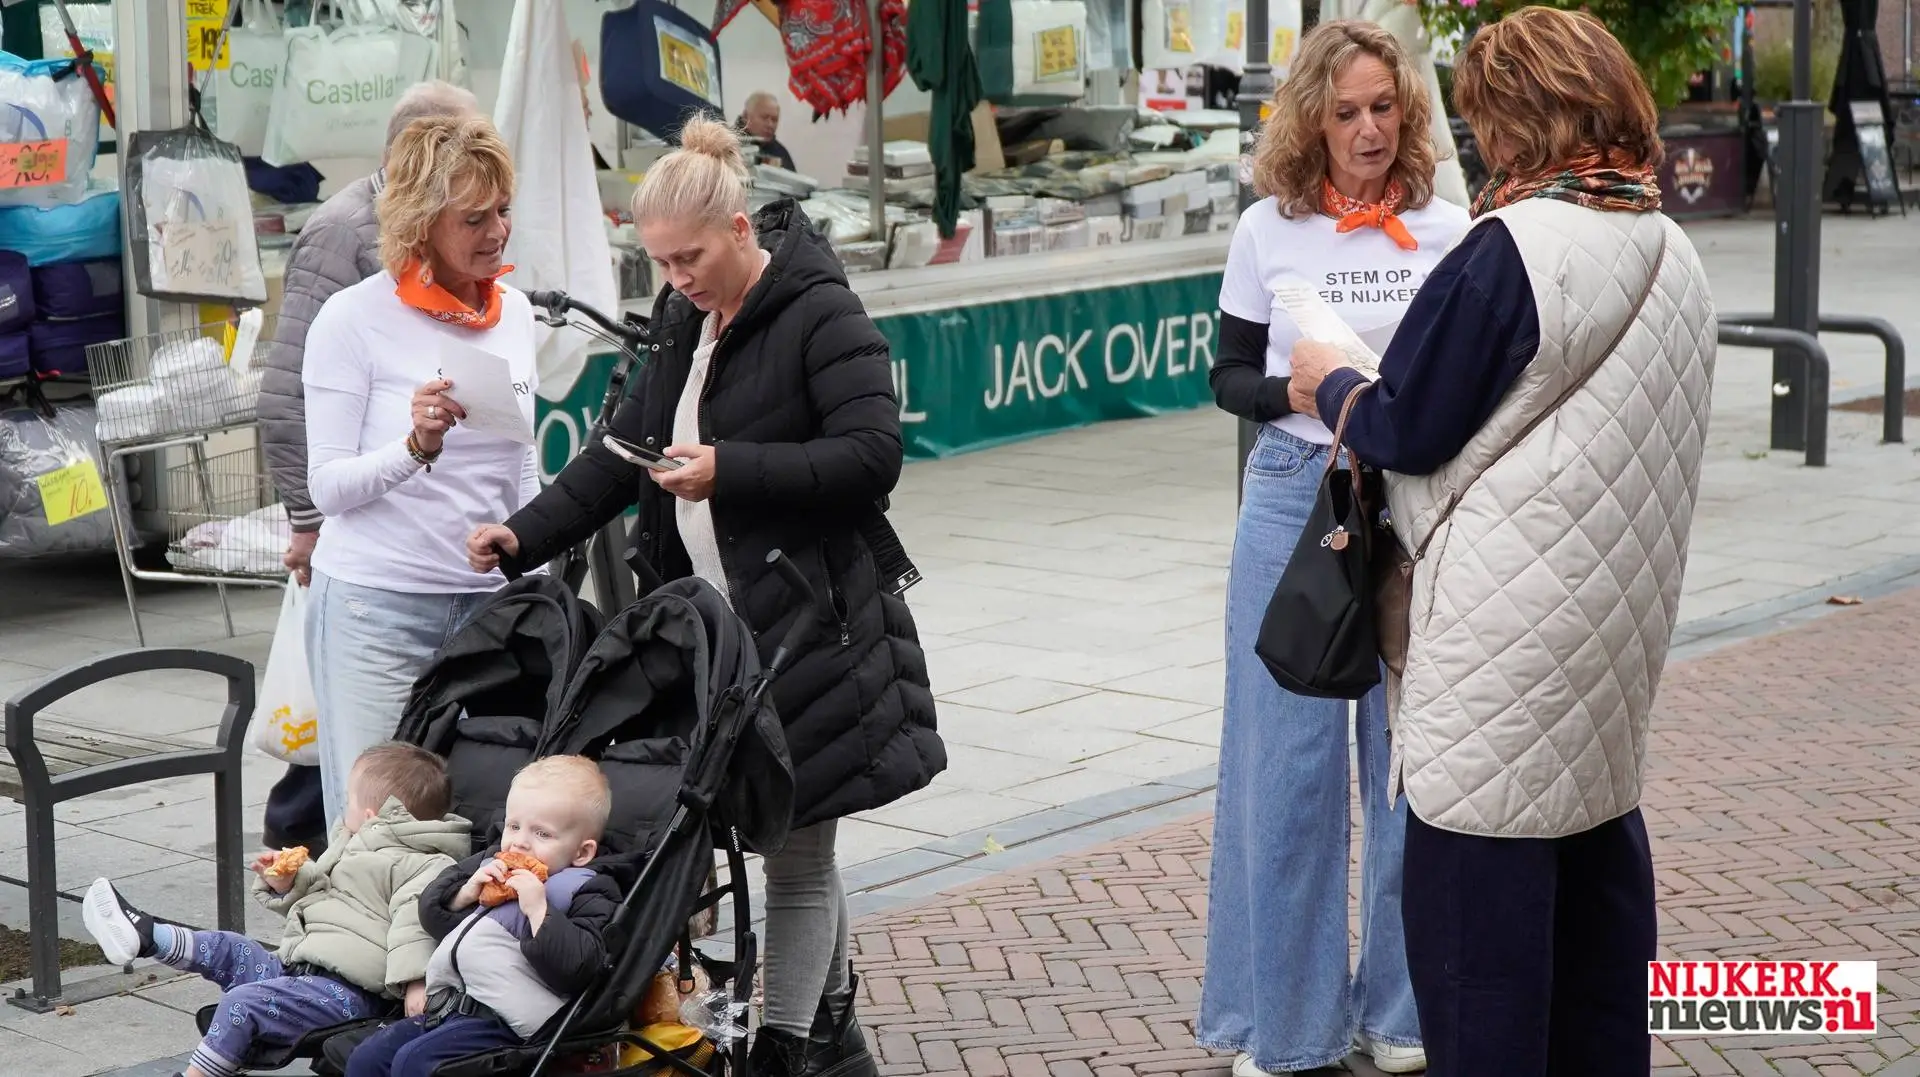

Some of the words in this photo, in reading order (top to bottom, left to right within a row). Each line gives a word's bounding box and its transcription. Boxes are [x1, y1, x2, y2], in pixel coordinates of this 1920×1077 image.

[306, 74, 395, 105] Castella
[1325, 269, 1379, 286] STEM
[1385, 269, 1412, 283] OP
[984, 329, 1093, 410] JACK
[1104, 309, 1221, 384] OVER
